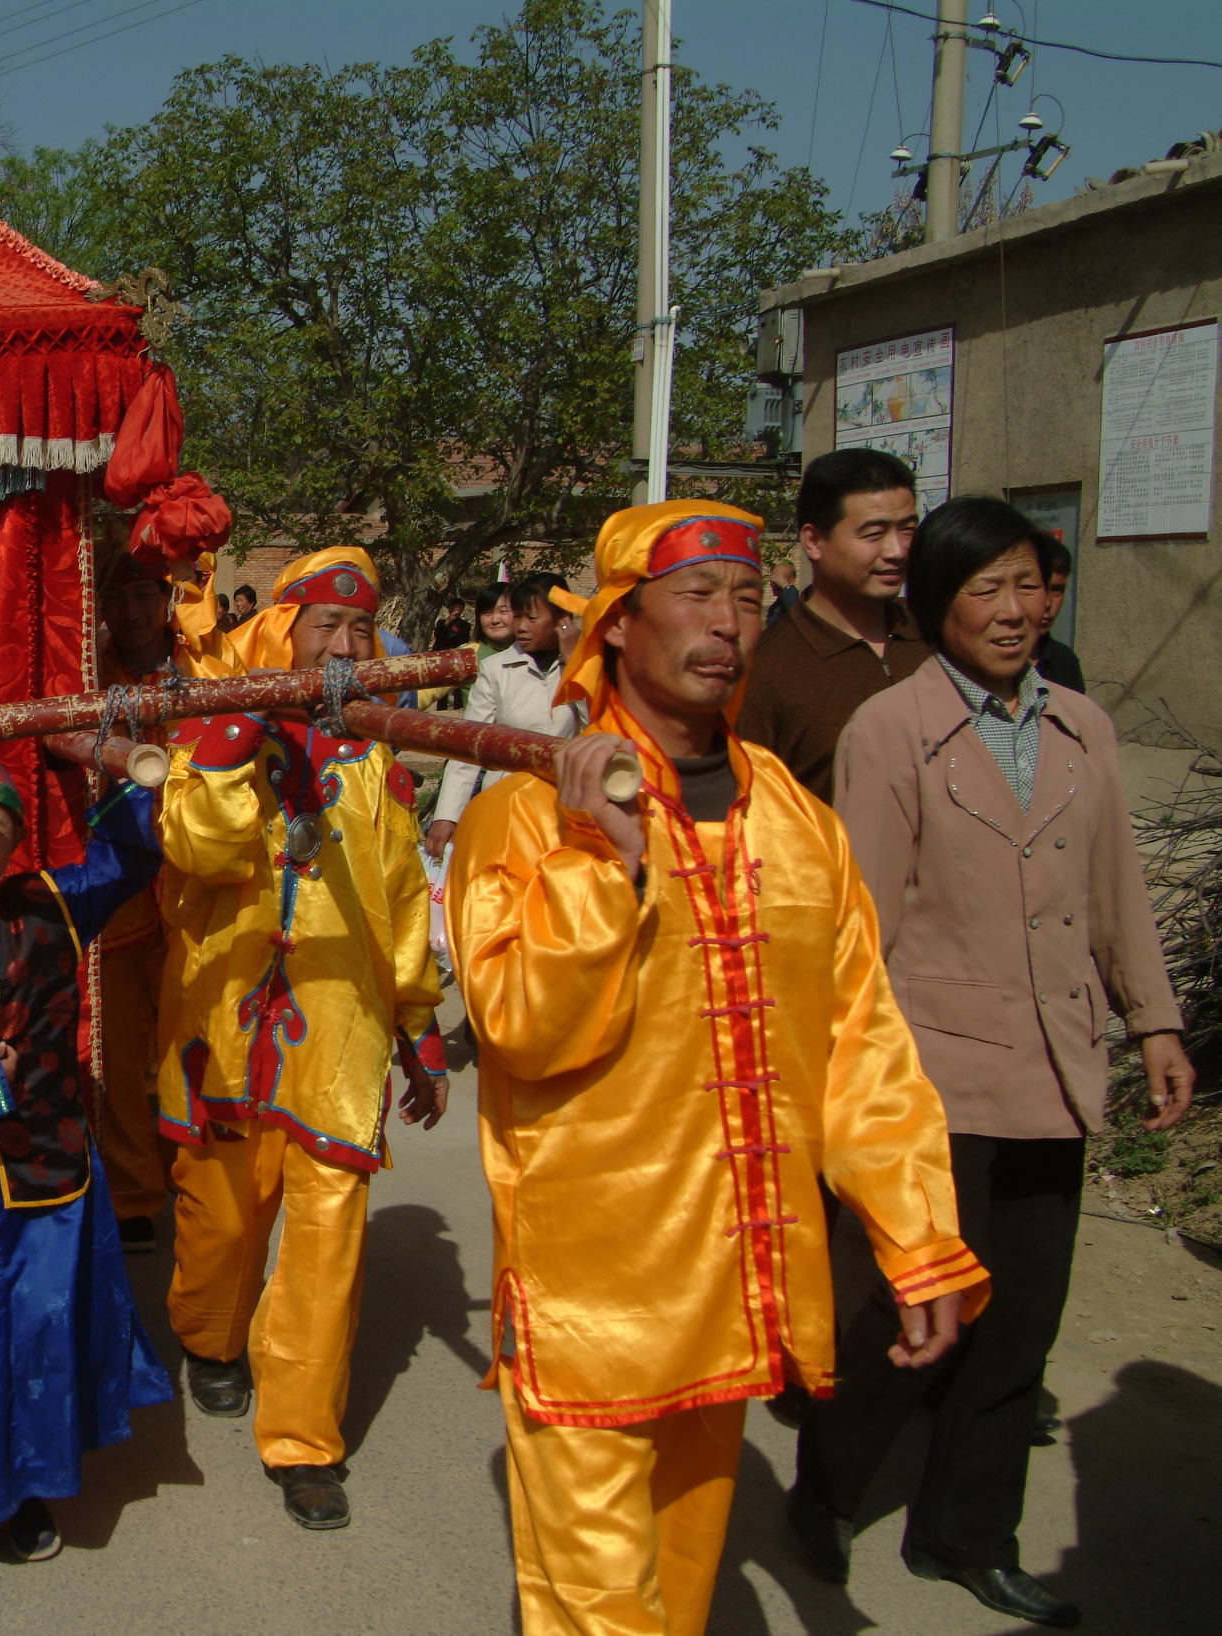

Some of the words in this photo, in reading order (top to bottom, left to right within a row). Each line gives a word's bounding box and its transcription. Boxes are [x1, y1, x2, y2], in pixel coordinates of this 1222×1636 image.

[839, 332, 950, 371] 农村安全用电宣传画
